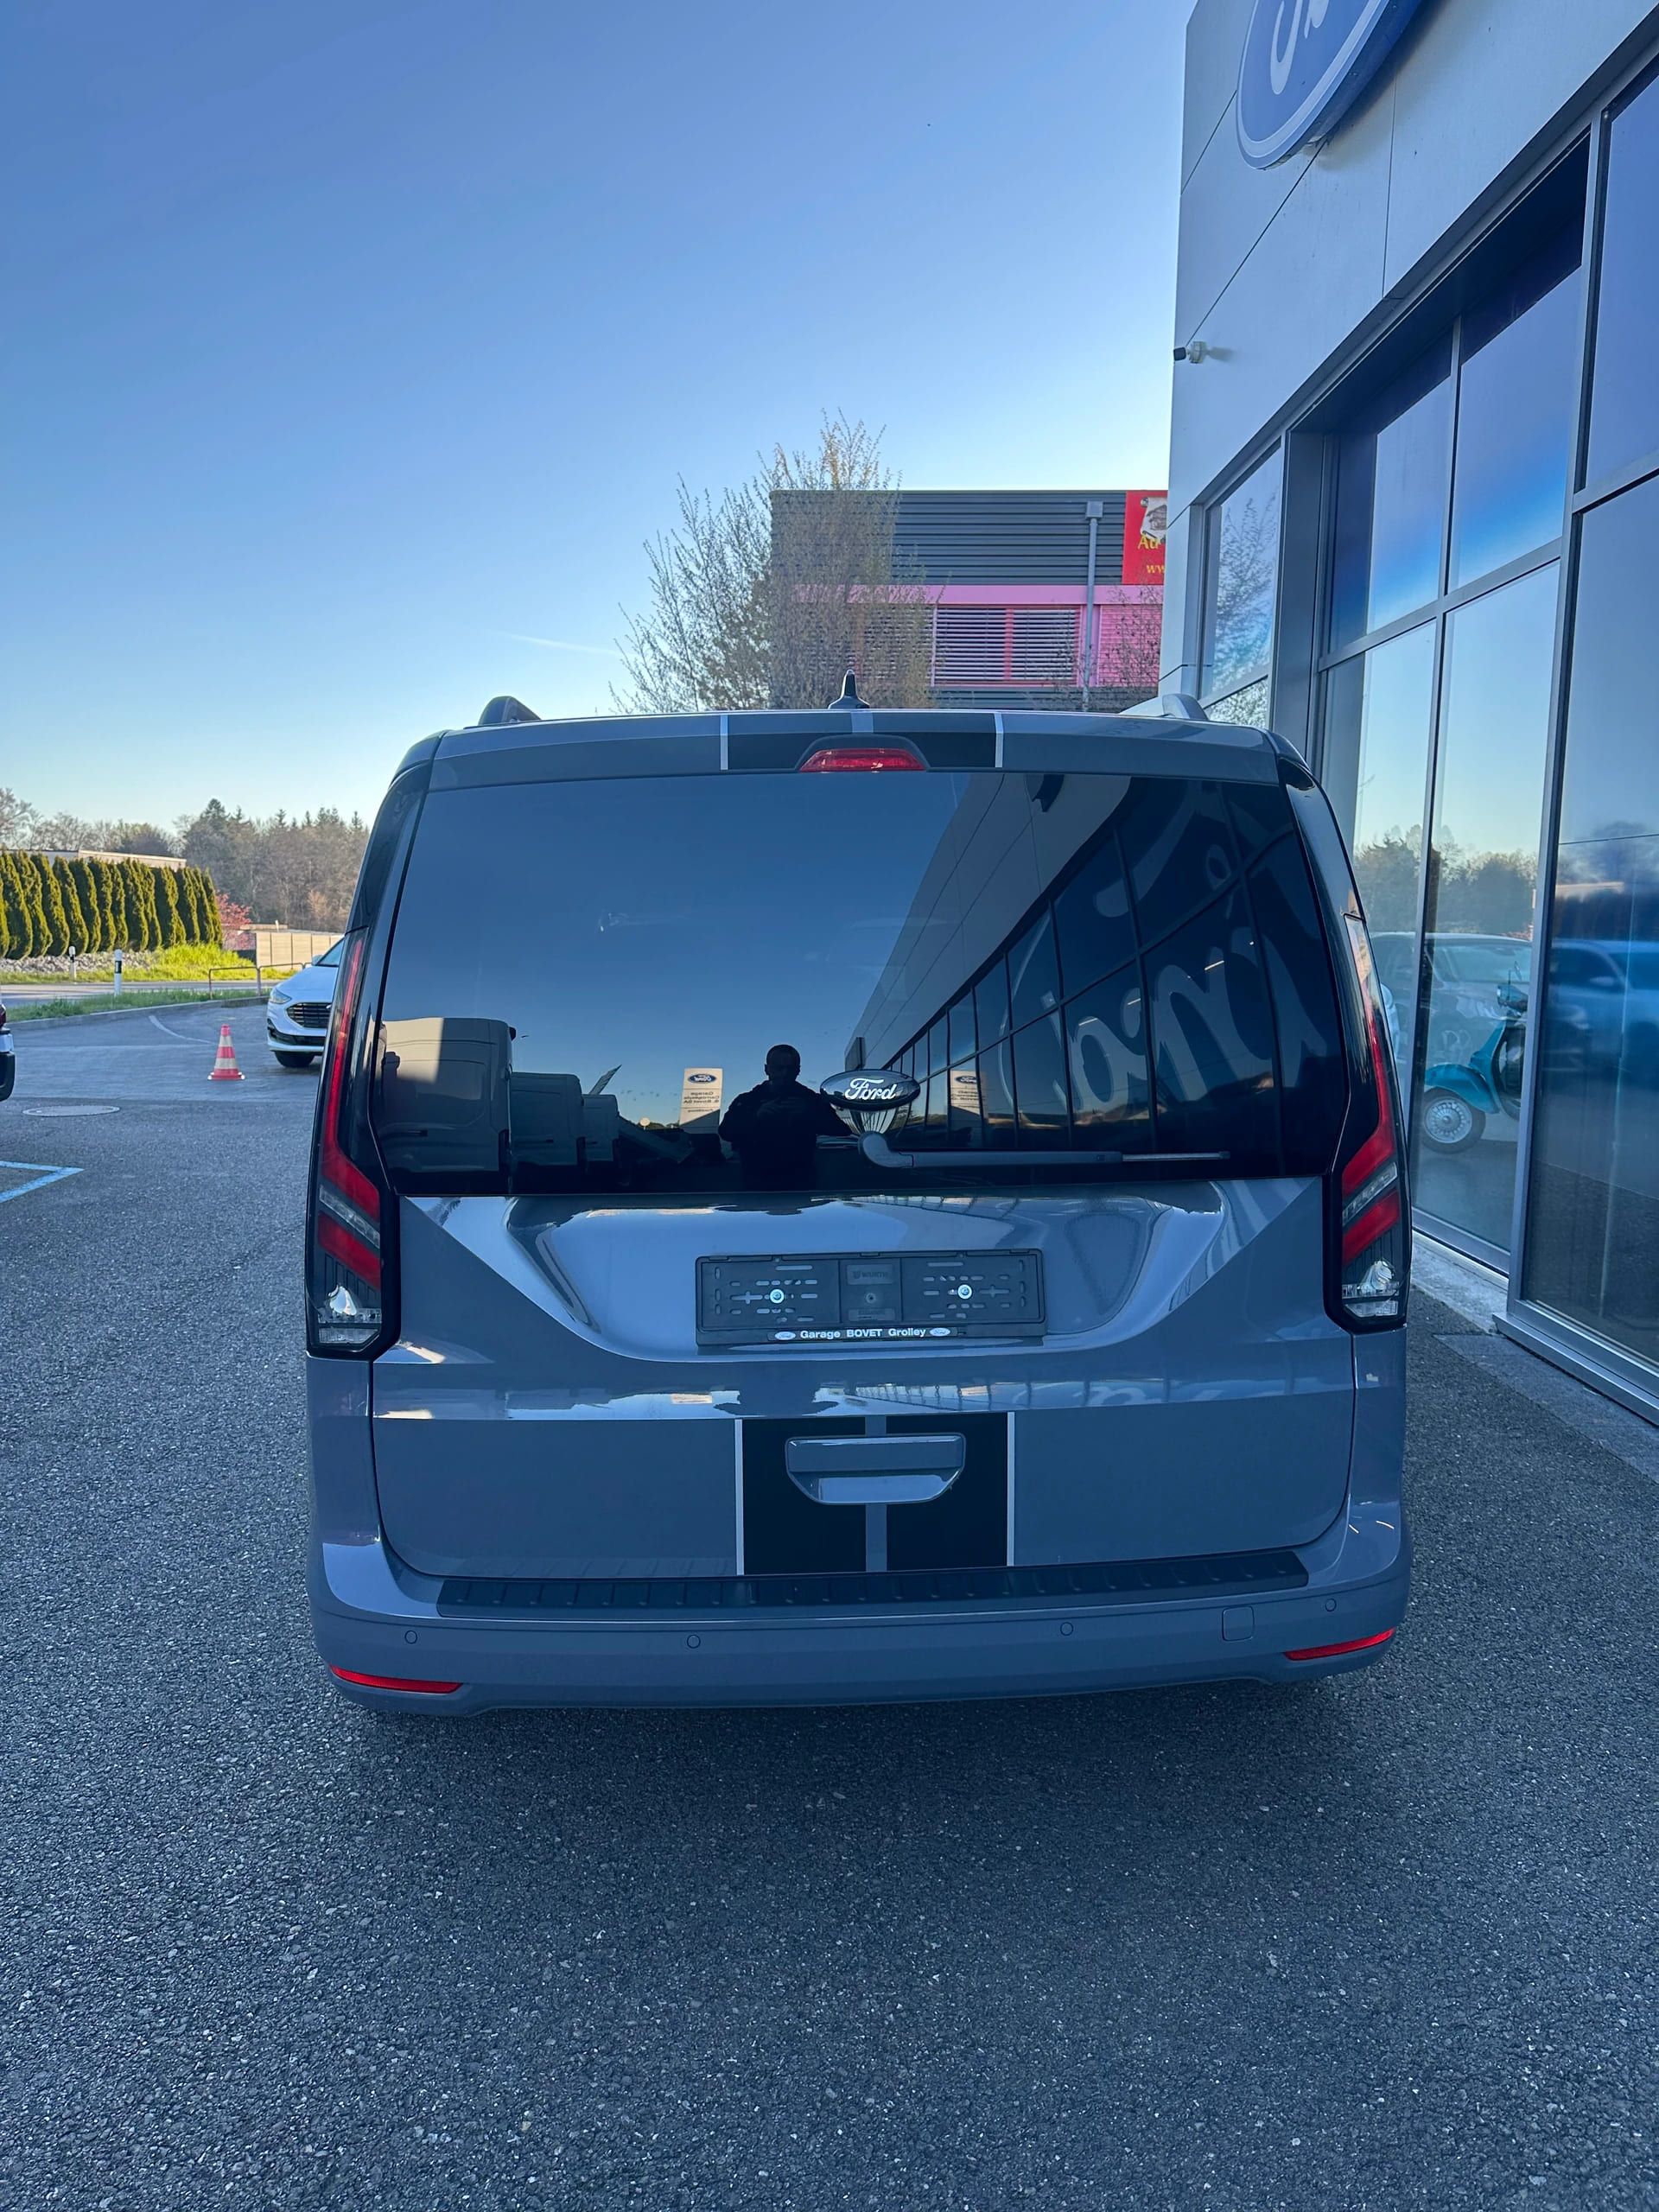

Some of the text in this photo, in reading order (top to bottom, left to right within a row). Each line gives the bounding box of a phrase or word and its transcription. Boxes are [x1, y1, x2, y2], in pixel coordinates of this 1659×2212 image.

[845, 1077, 897, 1100] Ford
[800, 1330, 841, 1340] Garage
[846, 1328, 883, 1338] BOVET
[888, 1327, 926, 1338] Grolley
